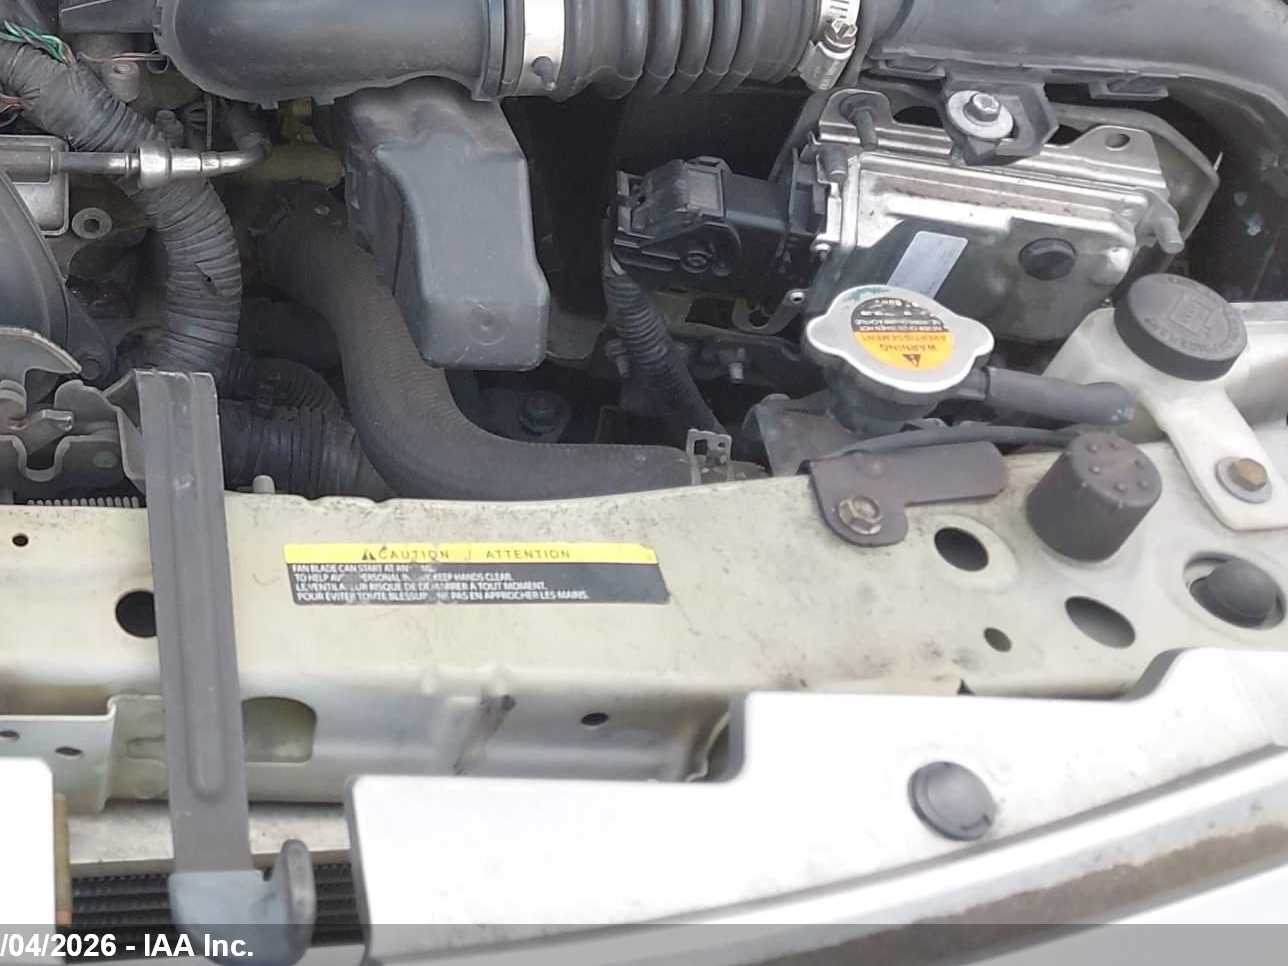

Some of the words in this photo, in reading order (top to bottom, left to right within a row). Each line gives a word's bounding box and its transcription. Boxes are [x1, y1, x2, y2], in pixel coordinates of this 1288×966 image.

[879, 343, 938, 352] WARNING
[378, 548, 450, 561] CAUTION
[486, 549, 571, 560] ATTENTION
[339, 564, 357, 573] CAN
[295, 573, 308, 582] TO
[309, 573, 330, 582] HELP
[433, 573, 454, 582] KEEP
[455, 572, 484, 582] HANDS
[485, 572, 514, 582] CLEAR.
[308, 583, 368, 592] VENTILAUR
[369, 583, 402, 592] RISQUE
[403, 582, 417, 592] DE
[478, 581, 502, 591] TOUT
[503, 581, 548, 591] MOMENT.
[297, 592, 323, 602] POUR
[355, 592, 386, 602] TOUTE
[388, 592, 435, 602] BLESSUR
[451, 591, 468, 601] PAS
[470, 591, 484, 601] EN
[485, 591, 539, 601] APPROCHER
[540, 591, 556, 600] LES
